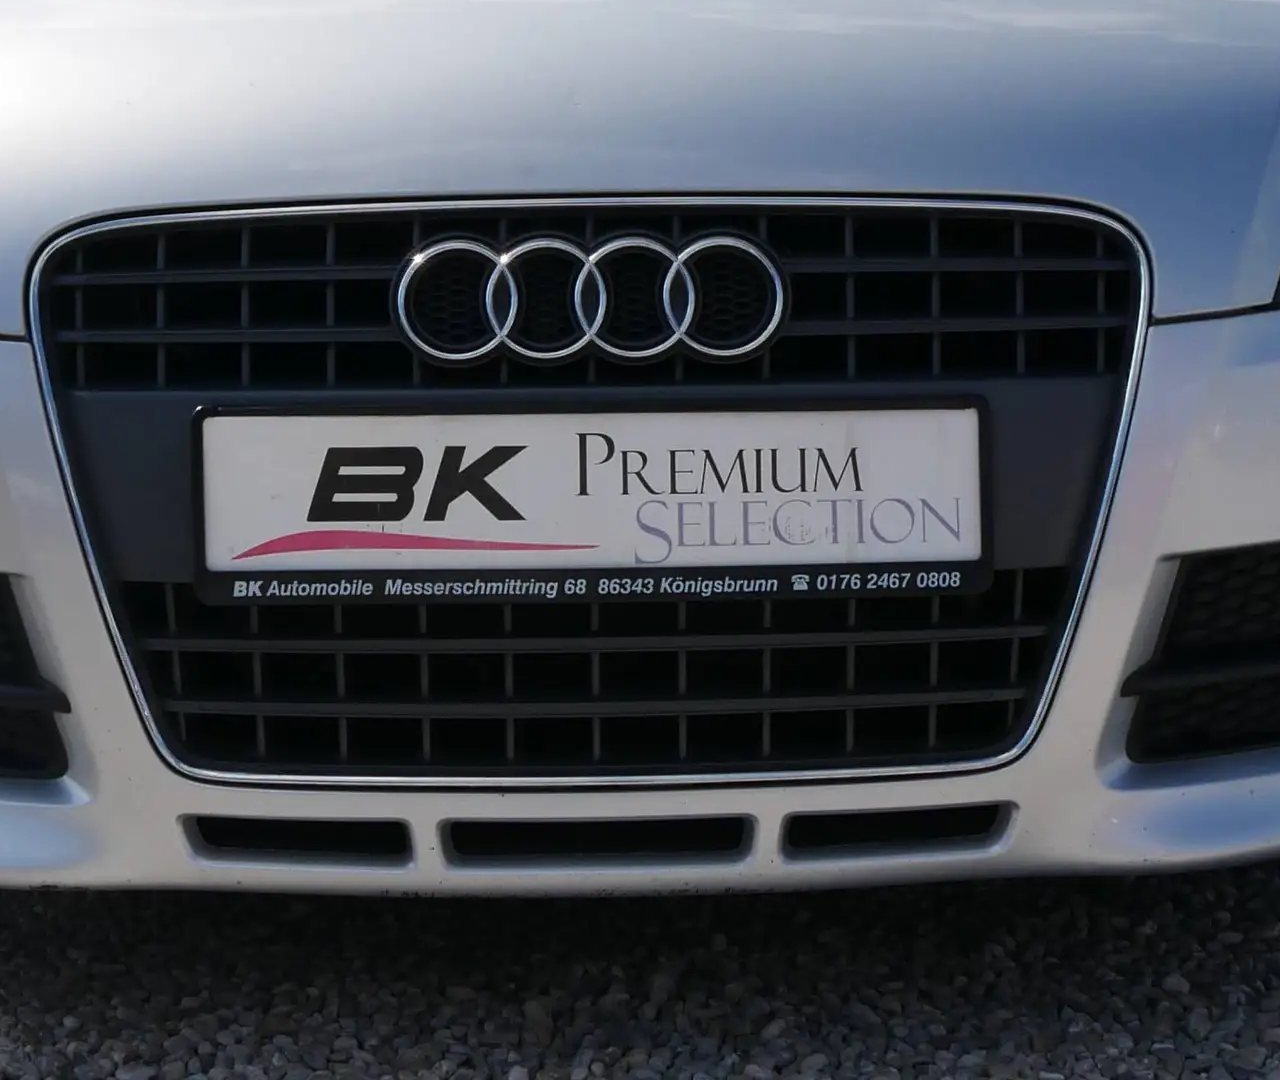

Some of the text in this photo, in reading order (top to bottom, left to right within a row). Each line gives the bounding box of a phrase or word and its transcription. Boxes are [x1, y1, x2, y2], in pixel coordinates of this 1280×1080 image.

[307, 445, 527, 522] BK
[233, 572, 960, 598] BK Automobile Messerschmittring 68 86343 Königsbrunn 0176 2467 0808
